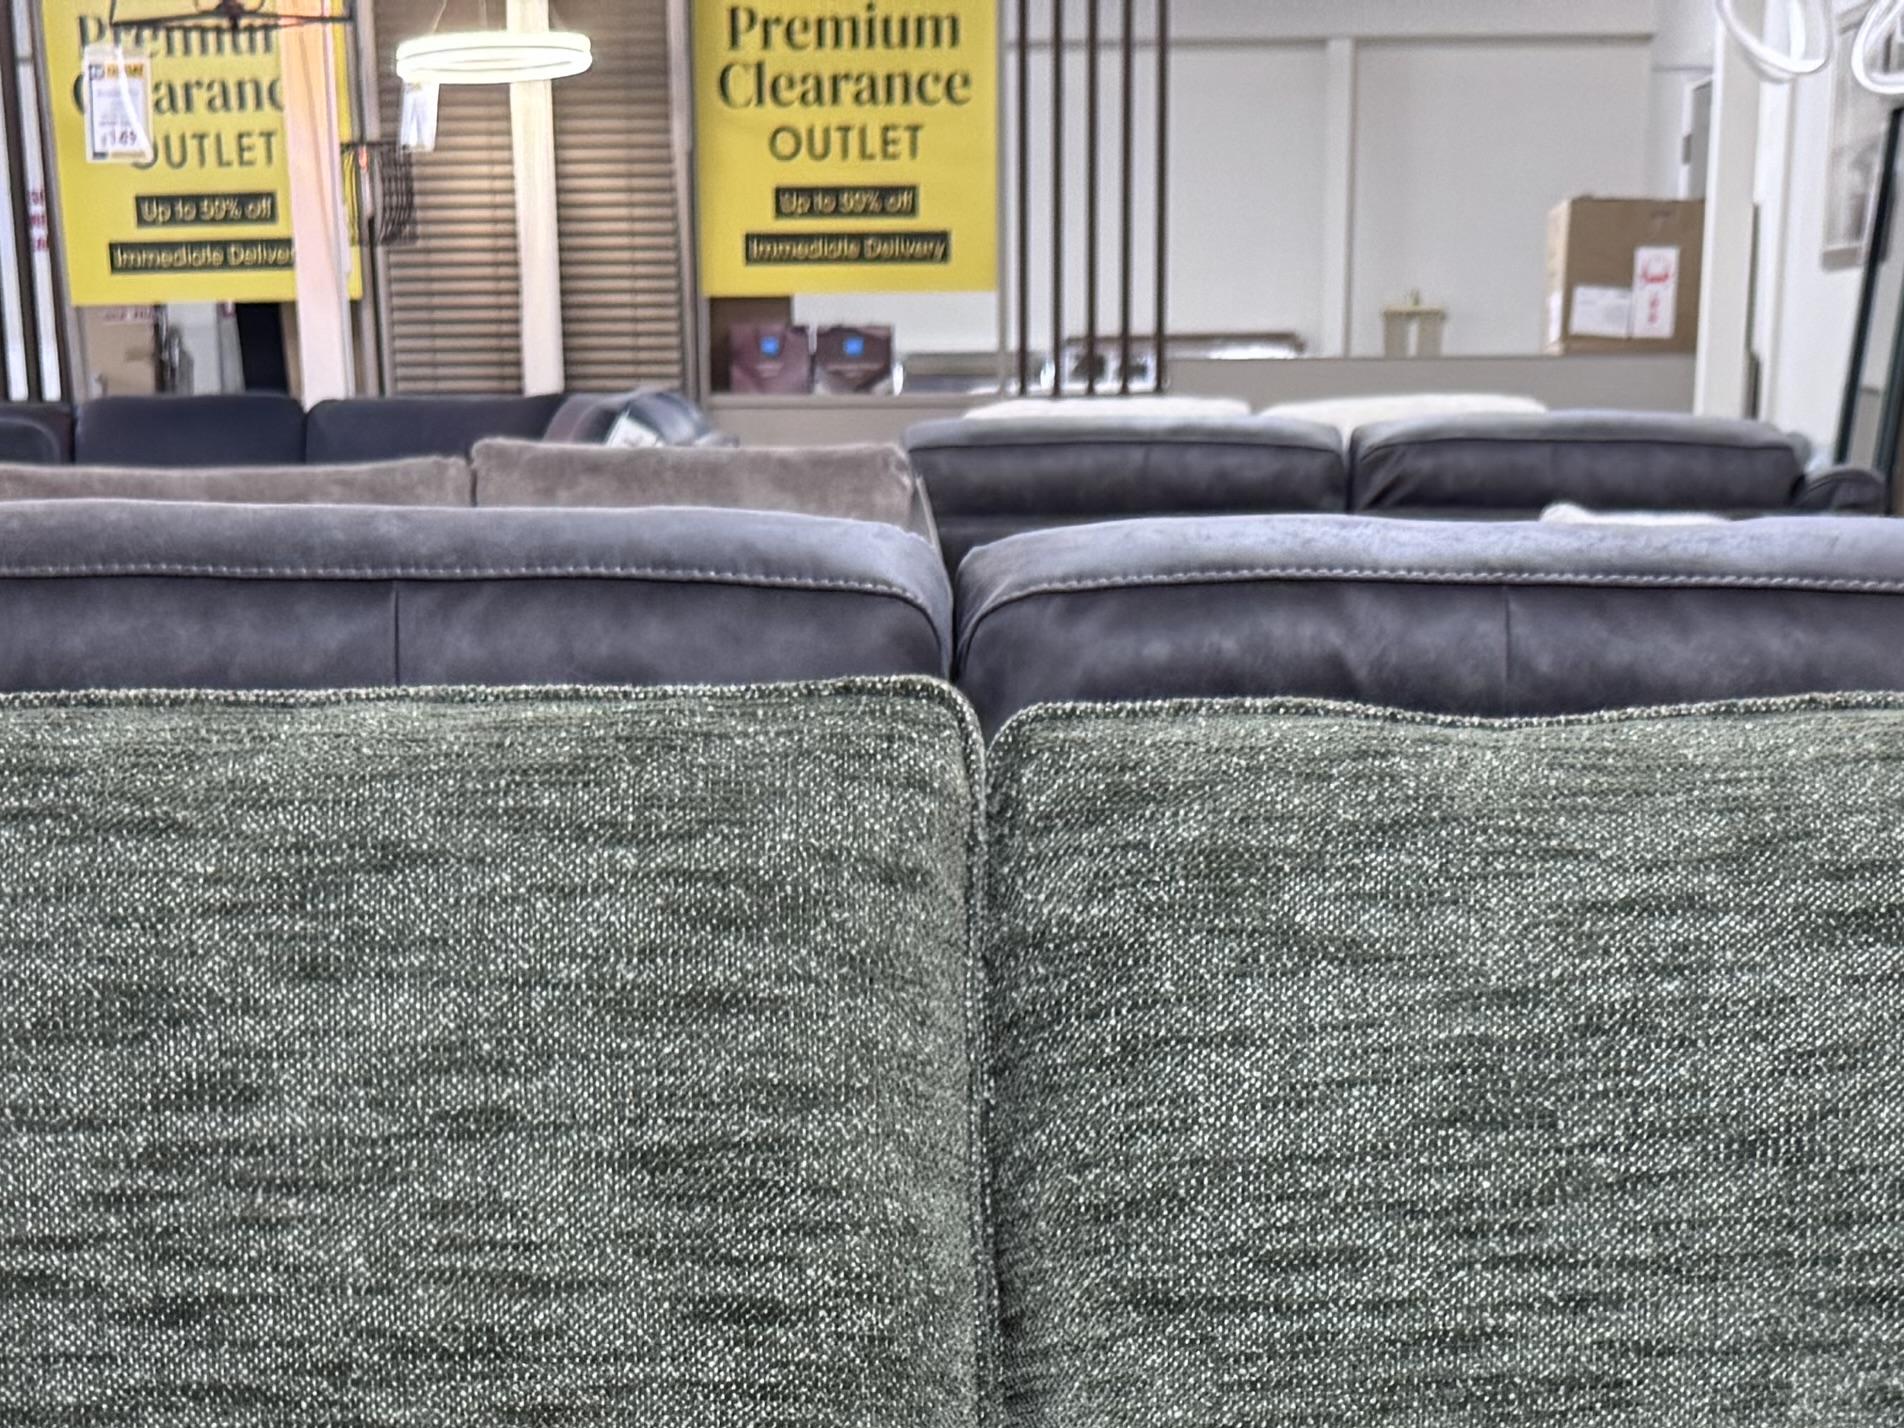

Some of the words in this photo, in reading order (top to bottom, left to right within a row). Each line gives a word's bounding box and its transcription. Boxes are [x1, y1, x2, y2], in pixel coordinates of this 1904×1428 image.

[727, 2, 960, 50] Premium
[718, 60, 972, 108] Clearance
[768, 123, 923, 161] OUTLET
[142, 200, 171, 224] Up
[175, 198, 196, 221] to
[779, 191, 810, 215] Up
[813, 191, 836, 213] to
[115, 245, 224, 269] Immediate
[752, 238, 860, 260] Immediate
[863, 237, 946, 260] Delivery
